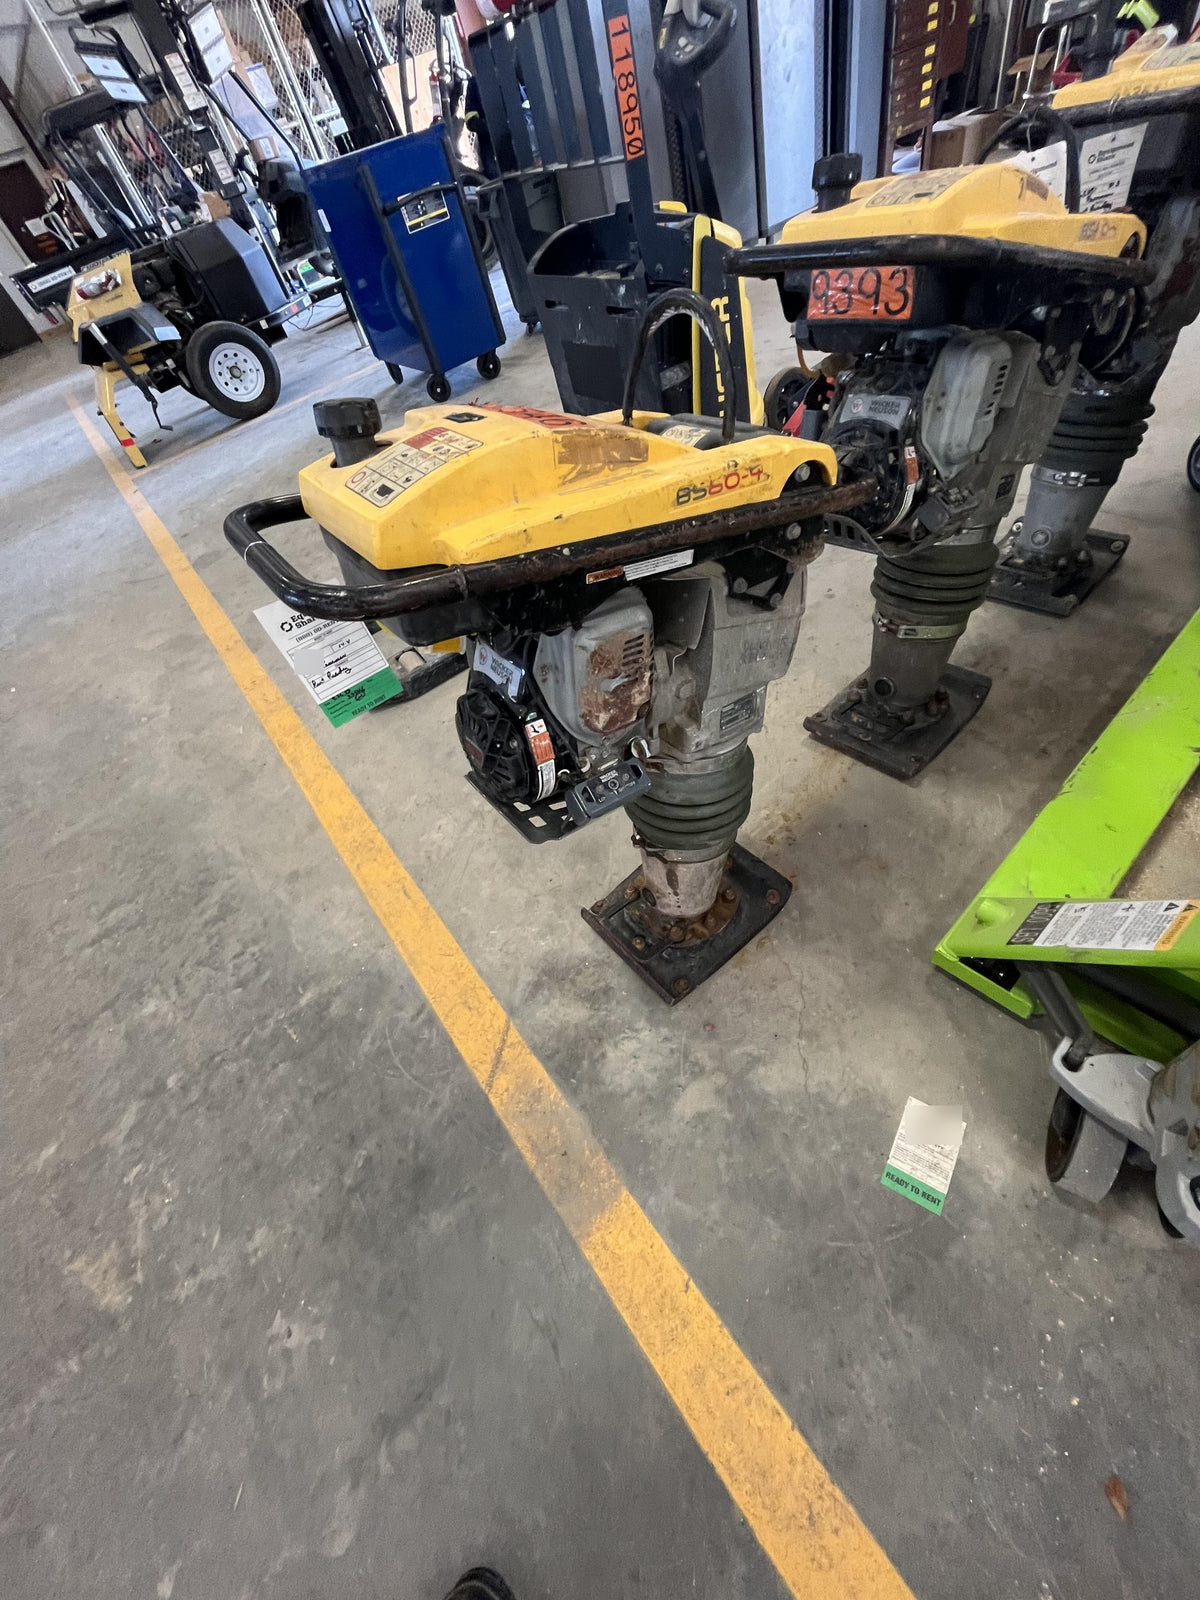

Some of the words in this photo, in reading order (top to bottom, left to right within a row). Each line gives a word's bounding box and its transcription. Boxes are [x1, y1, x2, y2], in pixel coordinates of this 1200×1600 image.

[612, 22, 643, 156] 118950
[813, 267, 909, 316] 9393
[295, 616, 316, 628] Shar
[490, 655, 514, 677] WACKER
[351, 705, 366, 716] READY
[885, 1171, 909, 1189] READY
[910, 1184, 920, 1195] TO
[921, 1191, 941, 1207] RENT
